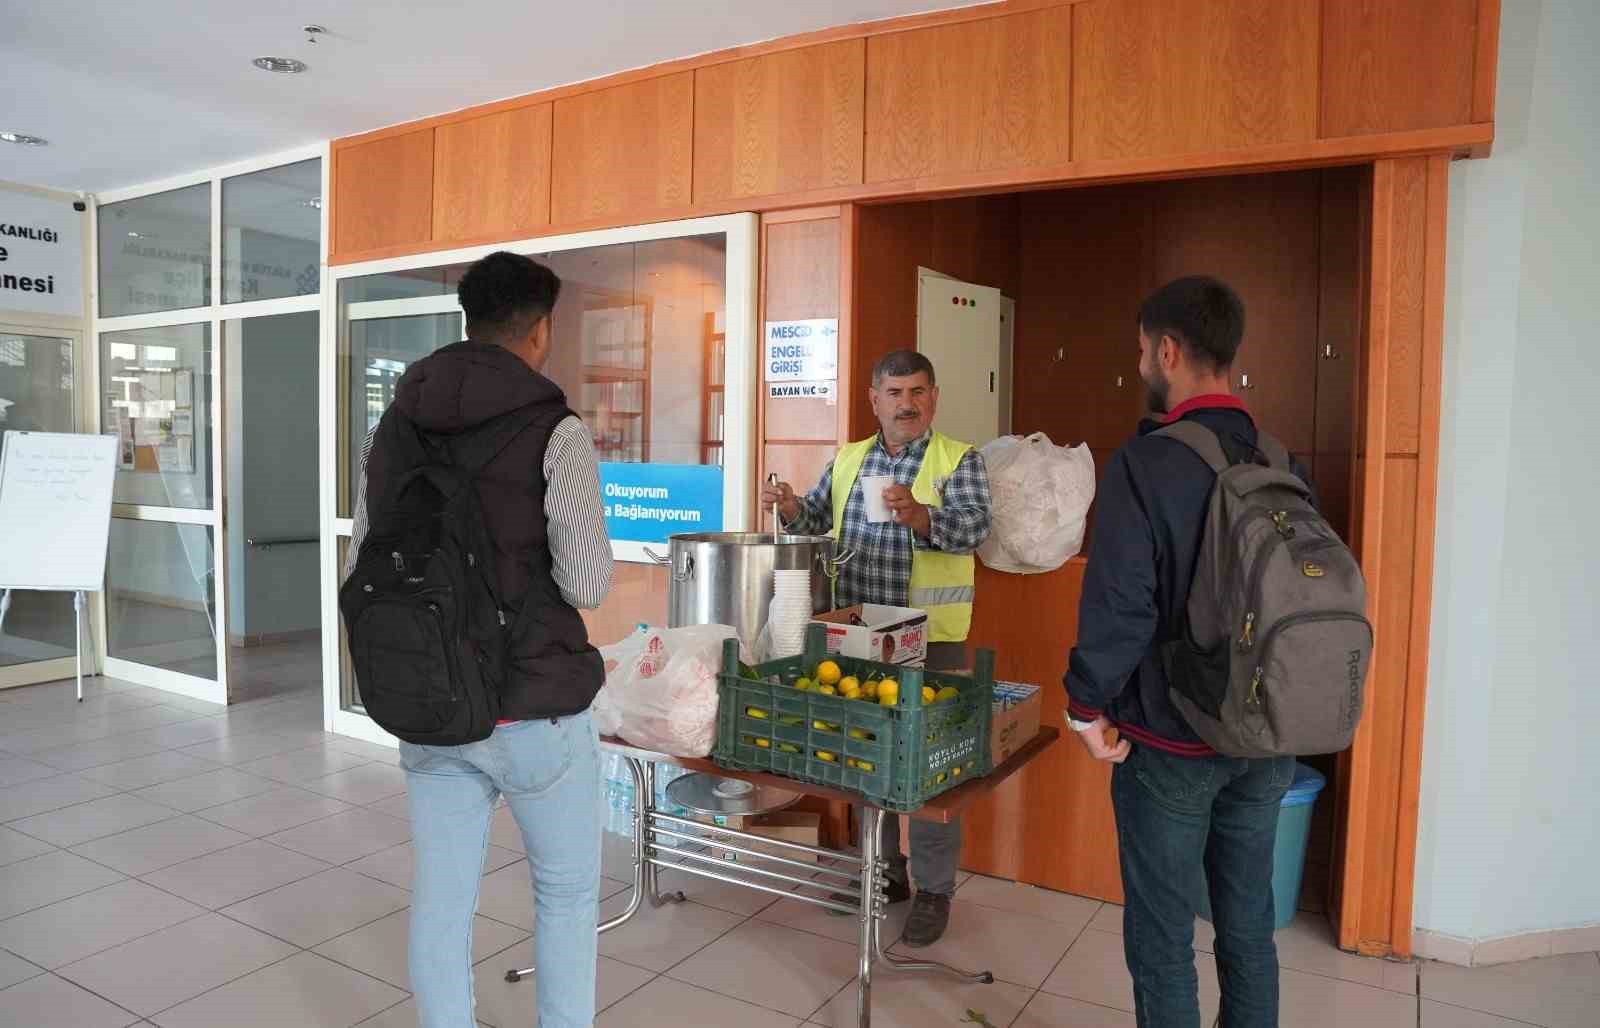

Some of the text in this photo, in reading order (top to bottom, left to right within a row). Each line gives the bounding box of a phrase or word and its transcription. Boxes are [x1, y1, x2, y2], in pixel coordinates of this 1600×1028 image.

[771, 385, 817, 397] BAYAN WC
[605, 482, 669, 500] Okuyorum
[614, 503, 701, 523] Bağlanıyorum
